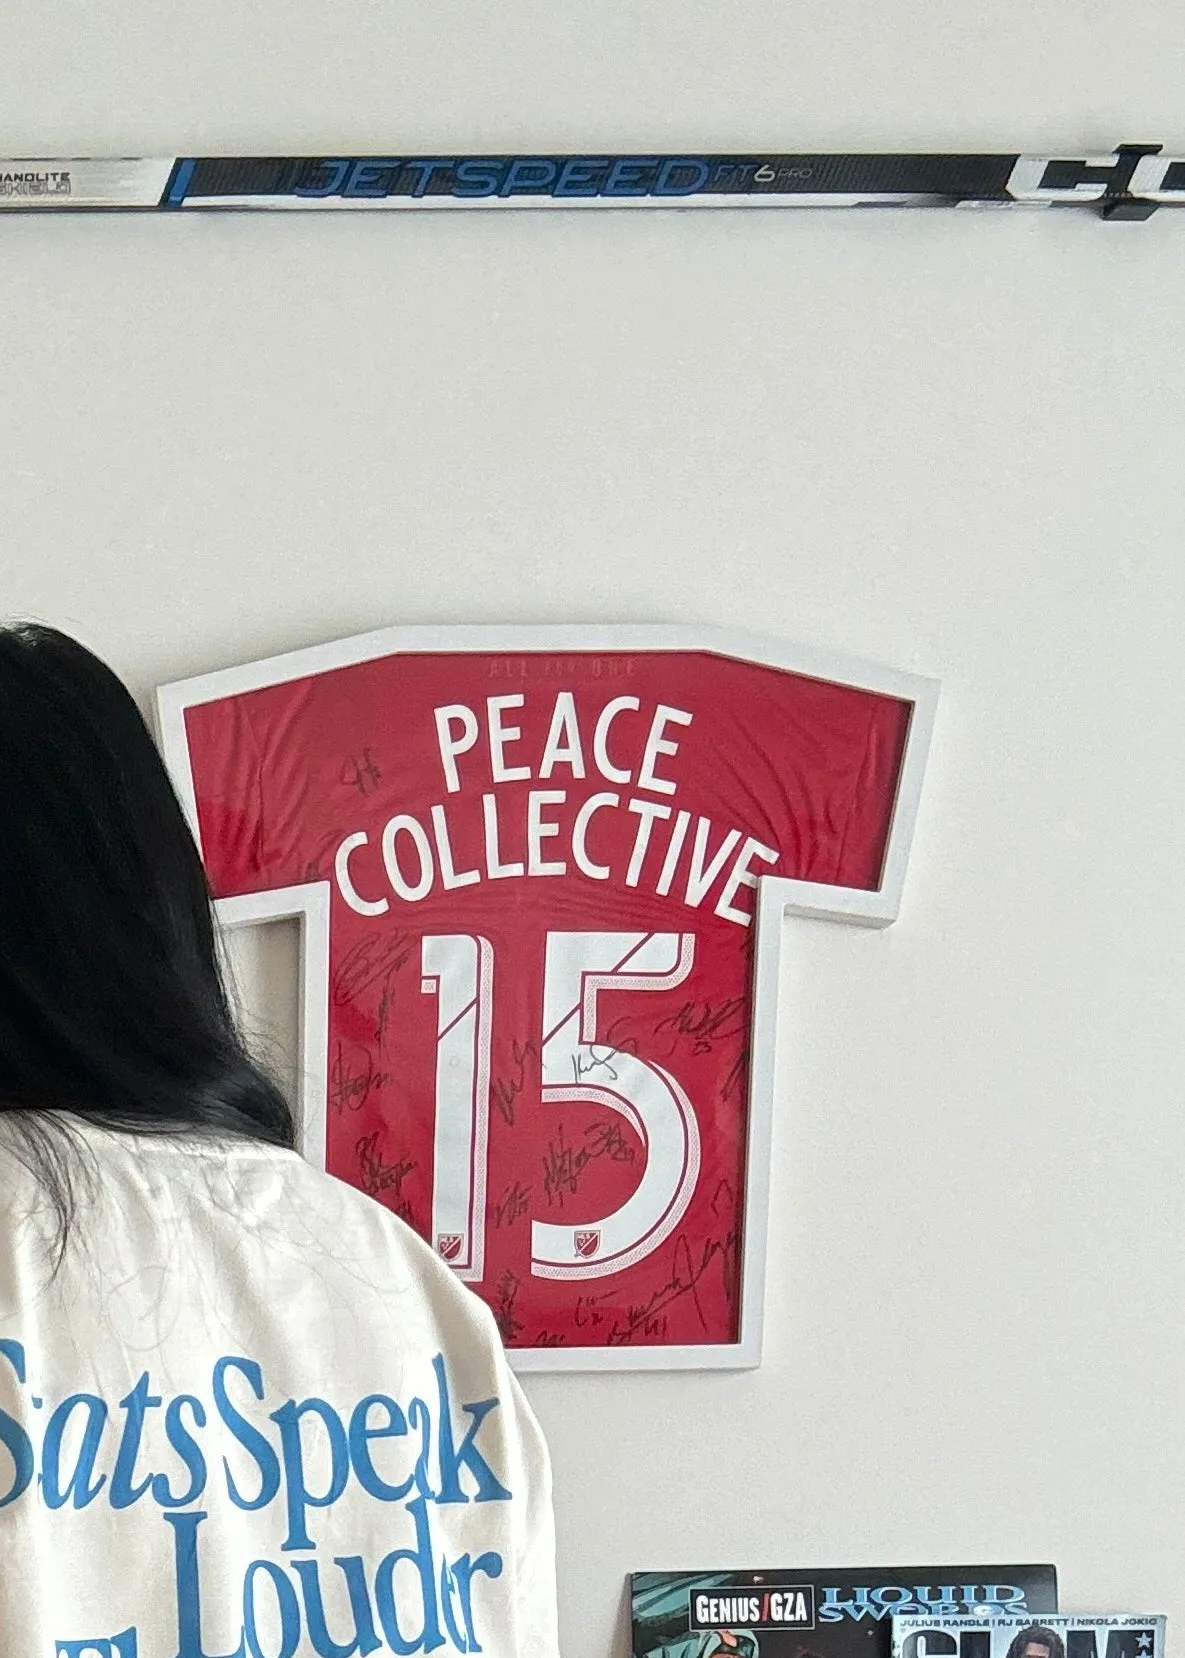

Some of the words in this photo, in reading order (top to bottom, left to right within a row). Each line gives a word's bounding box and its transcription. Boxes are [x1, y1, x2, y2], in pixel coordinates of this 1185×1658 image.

[295, 157, 711, 197] JETSPEED
[433, 691, 694, 795] PEACE
[334, 791, 780, 927] COLLECTIVE
[420, 931, 701, 1281] 15
